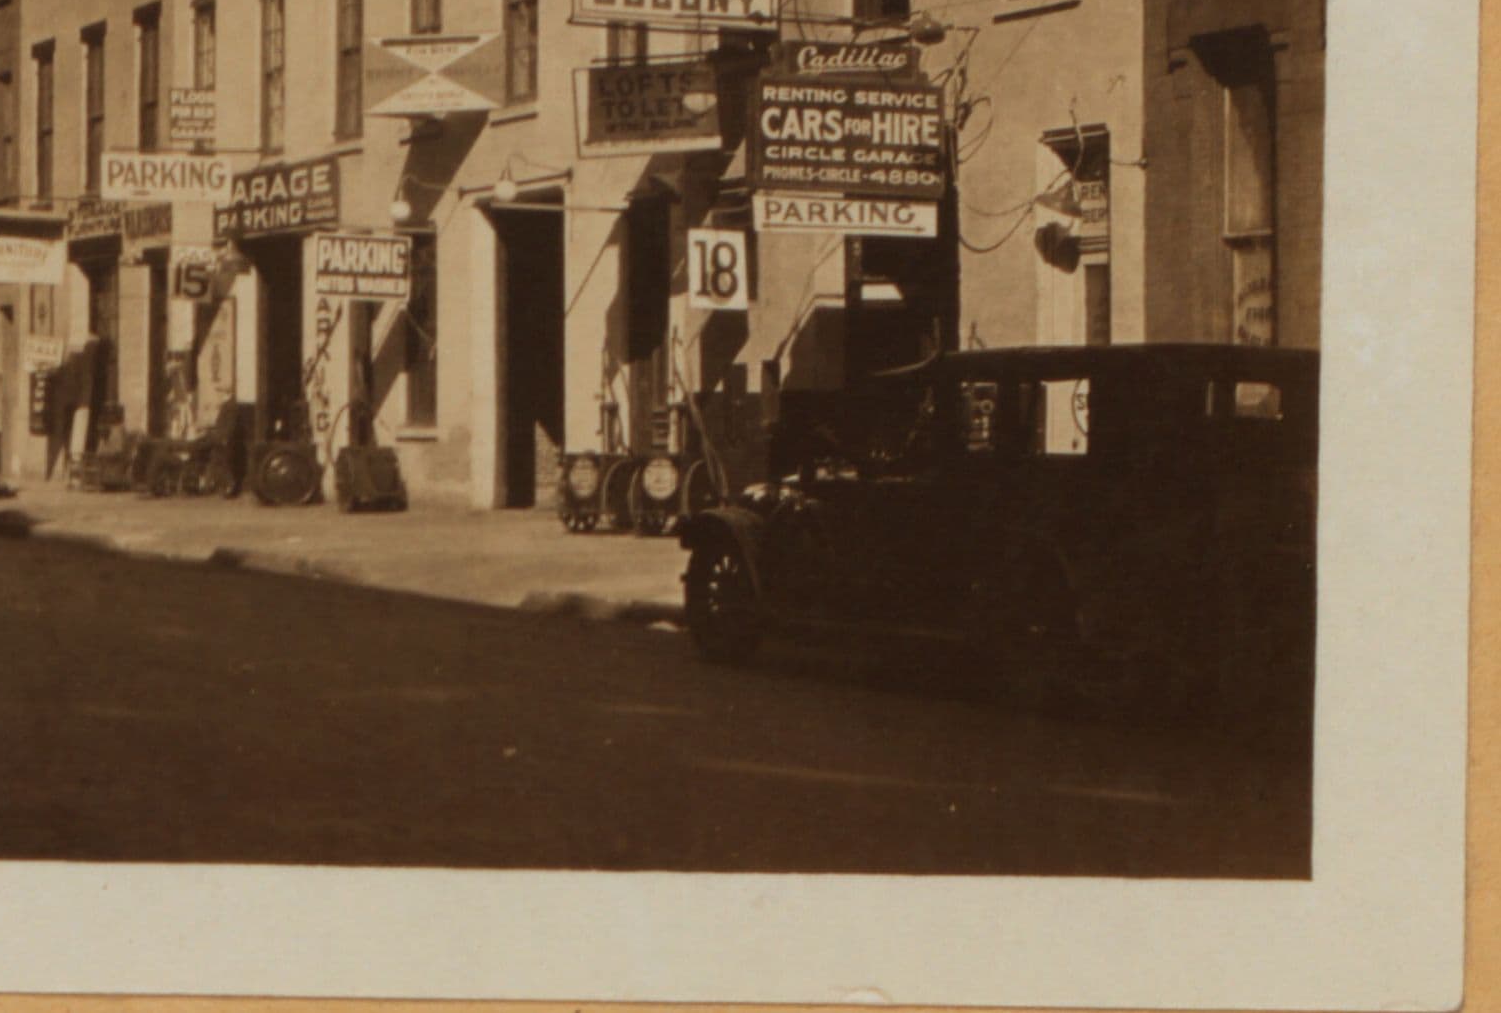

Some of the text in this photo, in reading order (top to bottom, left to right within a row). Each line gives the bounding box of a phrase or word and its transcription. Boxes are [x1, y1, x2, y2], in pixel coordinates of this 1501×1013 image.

[797, 44, 909, 70] Cadillac
[762, 85, 939, 109] RENTING SERVICE
[761, 105, 940, 146] CARS FOR HIRE
[764, 145, 937, 166] CIRCLE GARAGE
[107, 157, 227, 190] PARKING
[232, 163, 332, 206] ARAGE
[218, 202, 302, 235] PARKING
[764, 199, 916, 226] PARKING
[317, 239, 406, 274] PARKING
[693, 238, 740, 300] 18
[174, 262, 209, 299] 15
